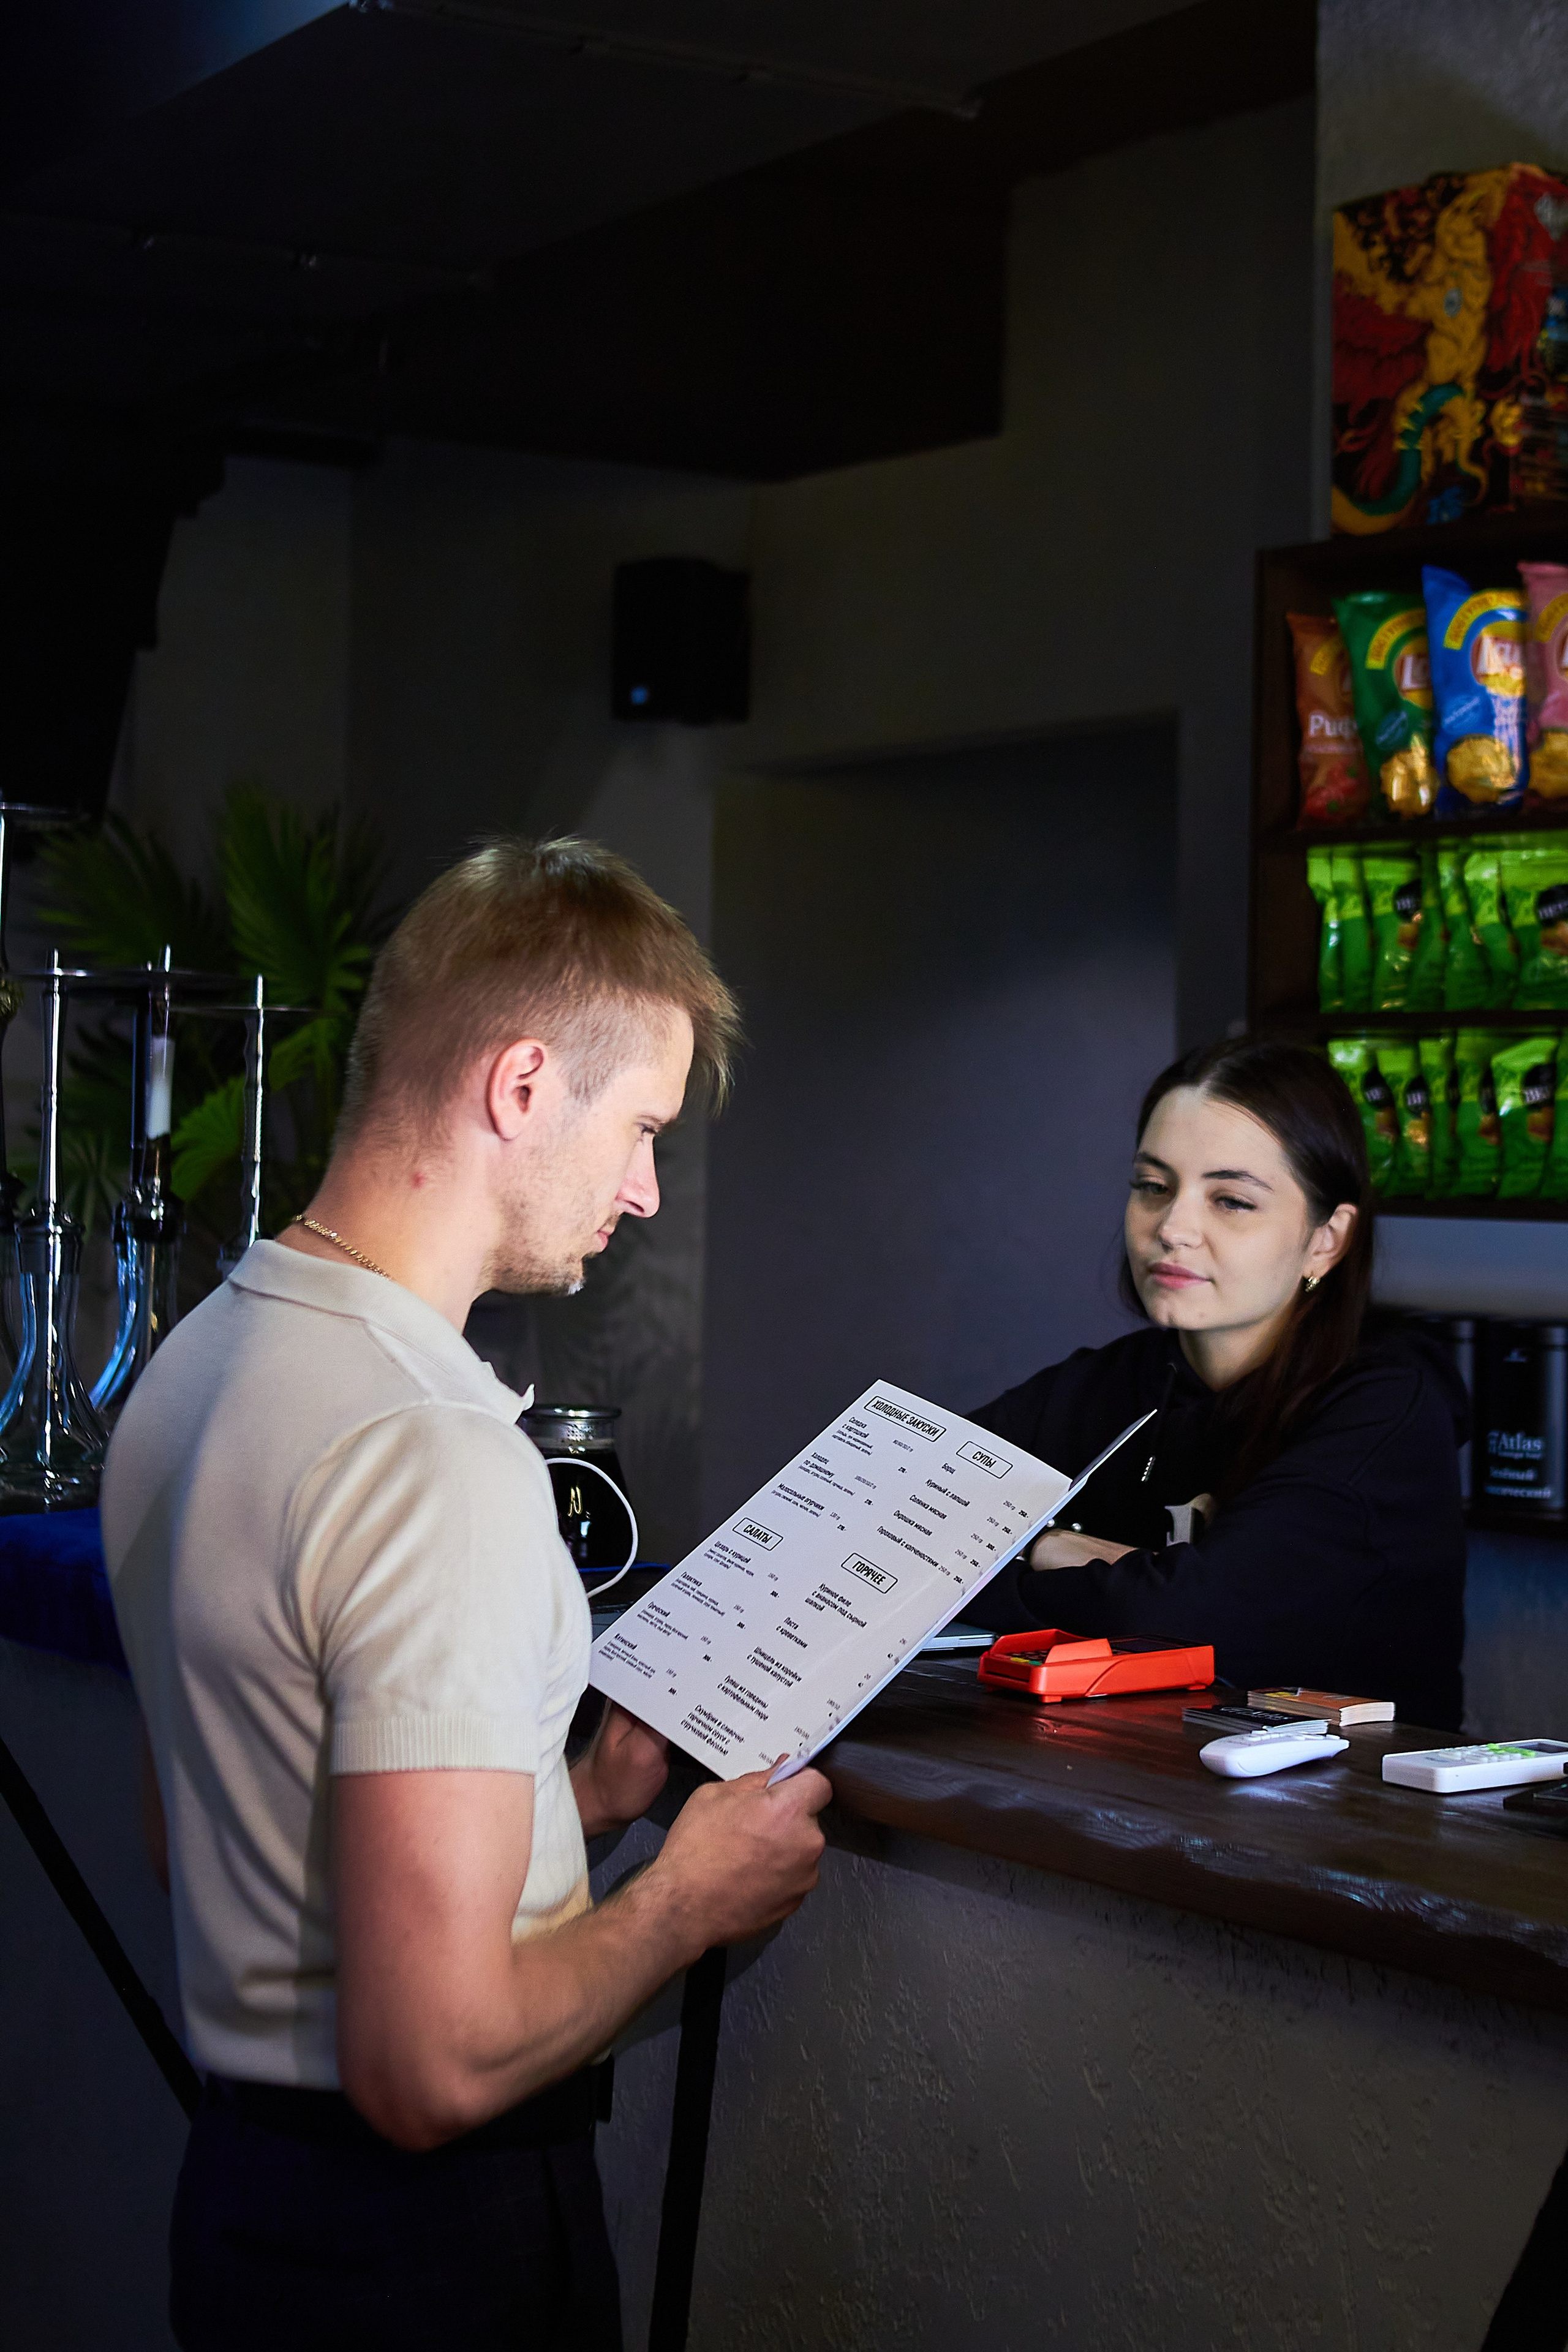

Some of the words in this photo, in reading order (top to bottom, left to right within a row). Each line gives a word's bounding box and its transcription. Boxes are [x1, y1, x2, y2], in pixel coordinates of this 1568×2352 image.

[872, 1400, 910, 1422] ХОЛОДНЫЕ
[906, 1417, 940, 1436] ЗАКУСКИ
[941, 1463, 956, 1474] Борщ
[972, 1451, 997, 1468] СУПЫ
[925, 1479, 948, 1494] Куриный
[949, 1493, 970, 1507] лапшой
[910, 1494, 930, 1509] Солянка
[929, 1507, 947, 1520] мясная
[743, 1525, 772, 1544] САЛАТЫ
[894, 1510, 915, 1526] Окрошка
[913, 1523, 932, 1536] мясная
[877, 1526, 903, 1544] Гороховый
[904, 1544, 939, 1567] копченостями
[852, 1561, 886, 1585] ГОРЯЧЕЕ
[805, 1598, 825, 1611] шапкой
[819, 1583, 839, 1599] Куриное
[838, 1596, 851, 1607] филе
[784, 1617, 799, 1629] Паста
[815, 1593, 839, 1610] ананасом
[837, 1607, 848, 1617] под
[846, 1613, 867, 1628] сырной
[780, 1628, 808, 1648] креветками
[751, 1656, 772, 1672] тушеной
[770, 1670, 793, 1687] капустой
[753, 1647, 775, 1664] Шницель
[781, 1666, 802, 1682] корейки
[721, 1686, 755, 1711] картофельным
[754, 1709, 768, 1721] пюре
[725, 1675, 739, 1689] Гуляш
[744, 1690, 768, 1708] говядины
